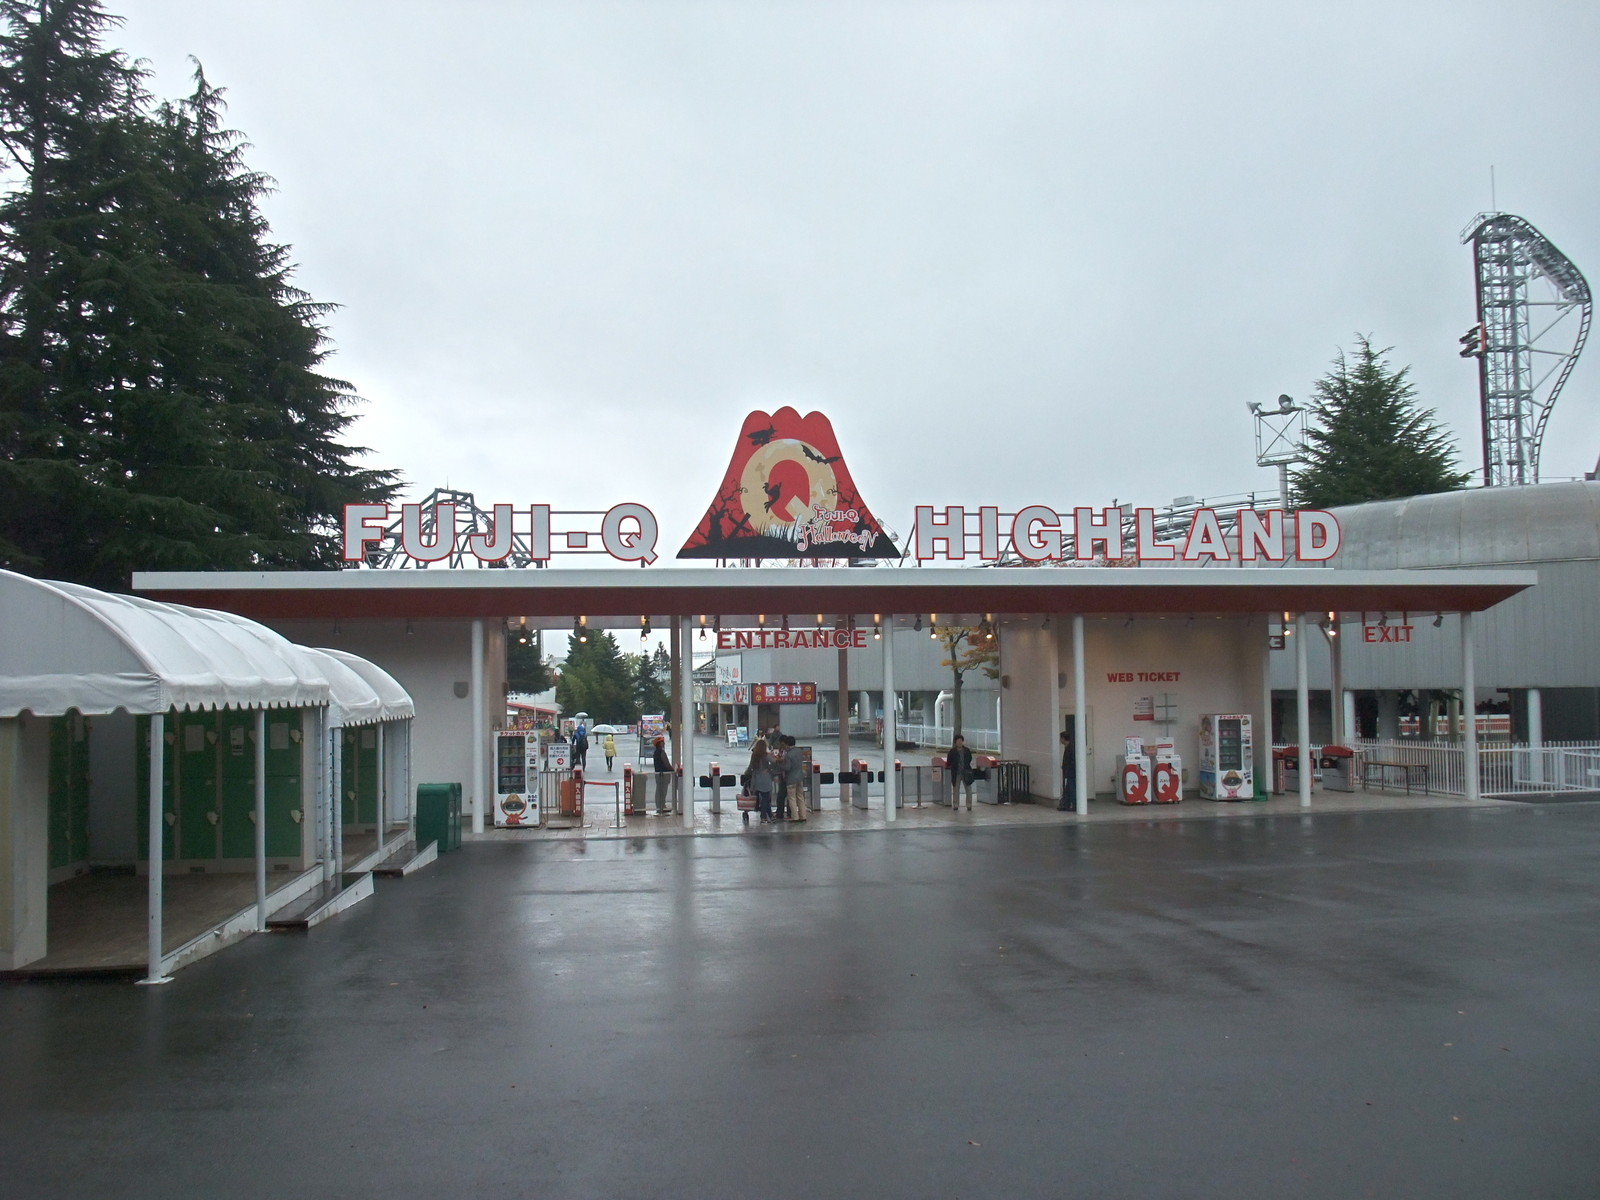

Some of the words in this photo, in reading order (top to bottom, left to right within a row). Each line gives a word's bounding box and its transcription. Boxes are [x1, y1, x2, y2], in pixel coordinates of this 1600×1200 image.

[812, 504, 860, 523] FUJI-Q
[343, 502, 659, 566] FUJI-Q
[914, 504, 1341, 562] HIGHLAND
[717, 629, 868, 650] ENTRANCE
[1364, 625, 1414, 643] EXIT
[1107, 673, 1134, 683] WEB
[1137, 672, 1181, 683] TICKET
